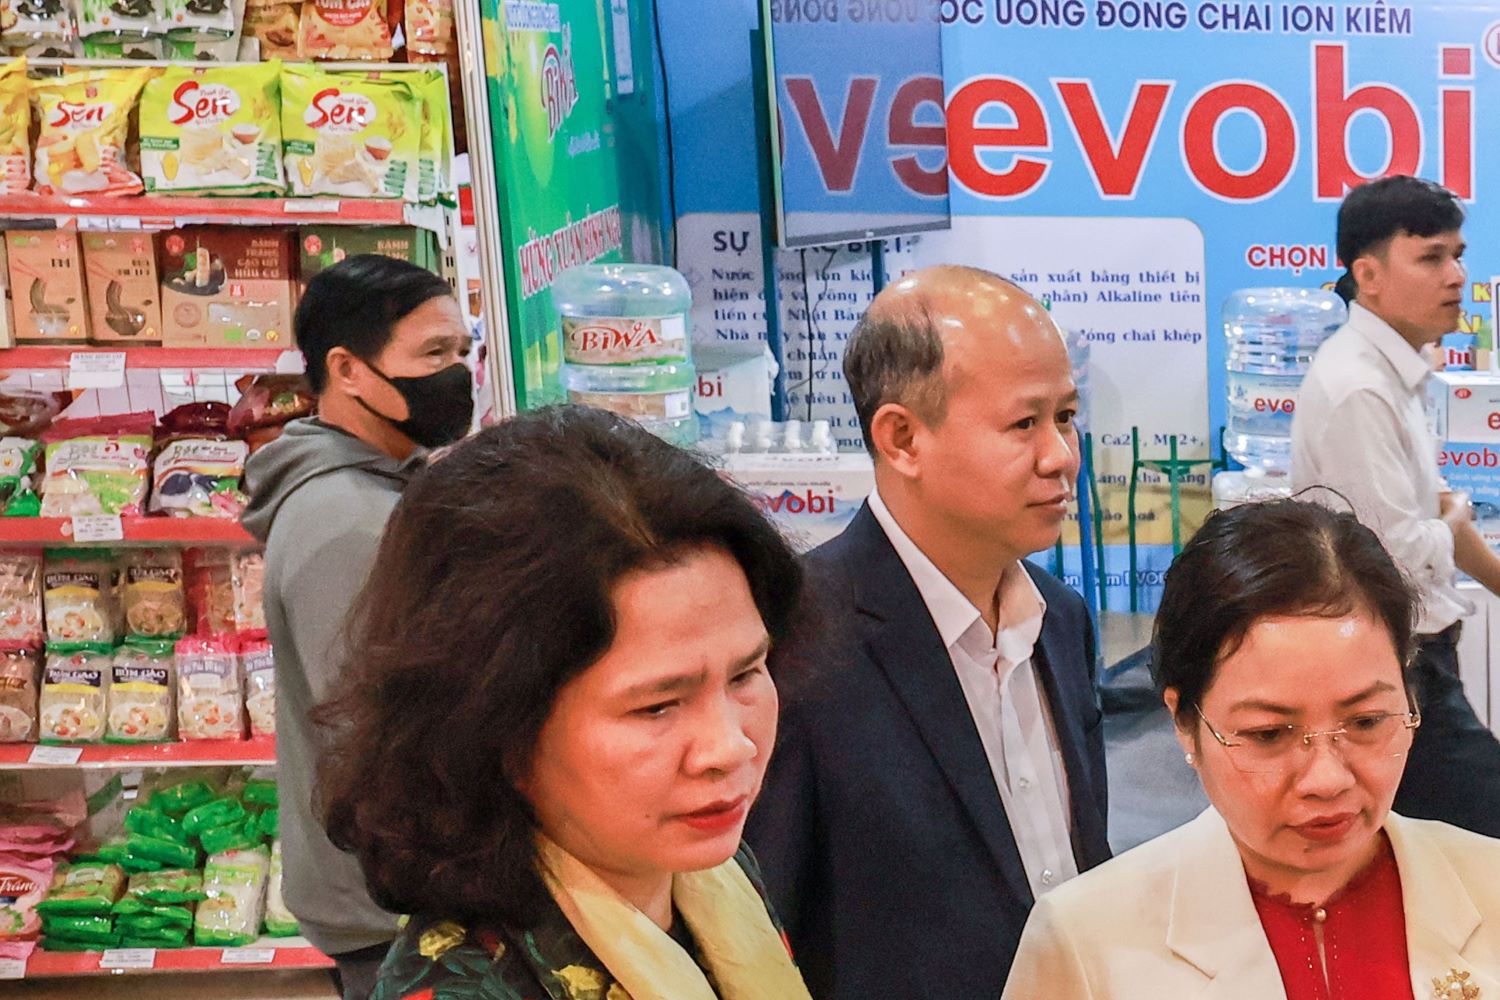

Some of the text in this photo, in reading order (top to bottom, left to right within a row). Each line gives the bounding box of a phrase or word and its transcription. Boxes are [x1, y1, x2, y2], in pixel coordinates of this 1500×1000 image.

[1200, 3, 1271, 31] CHAI
[1282, 5, 1333, 32] ION
[171, 80, 235, 125] Sen
[306, 88, 368, 129] Sen
[946, 43, 1473, 200] evobi
[712, 230, 750, 256] SỰ
[1248, 245, 1326, 274] CHỌN
[1097, 290, 1163, 304] Alkaline
[1123, 328, 1157, 342] chai
[1254, 397, 1295, 414] evo
[768, 488, 834, 514] vobi
